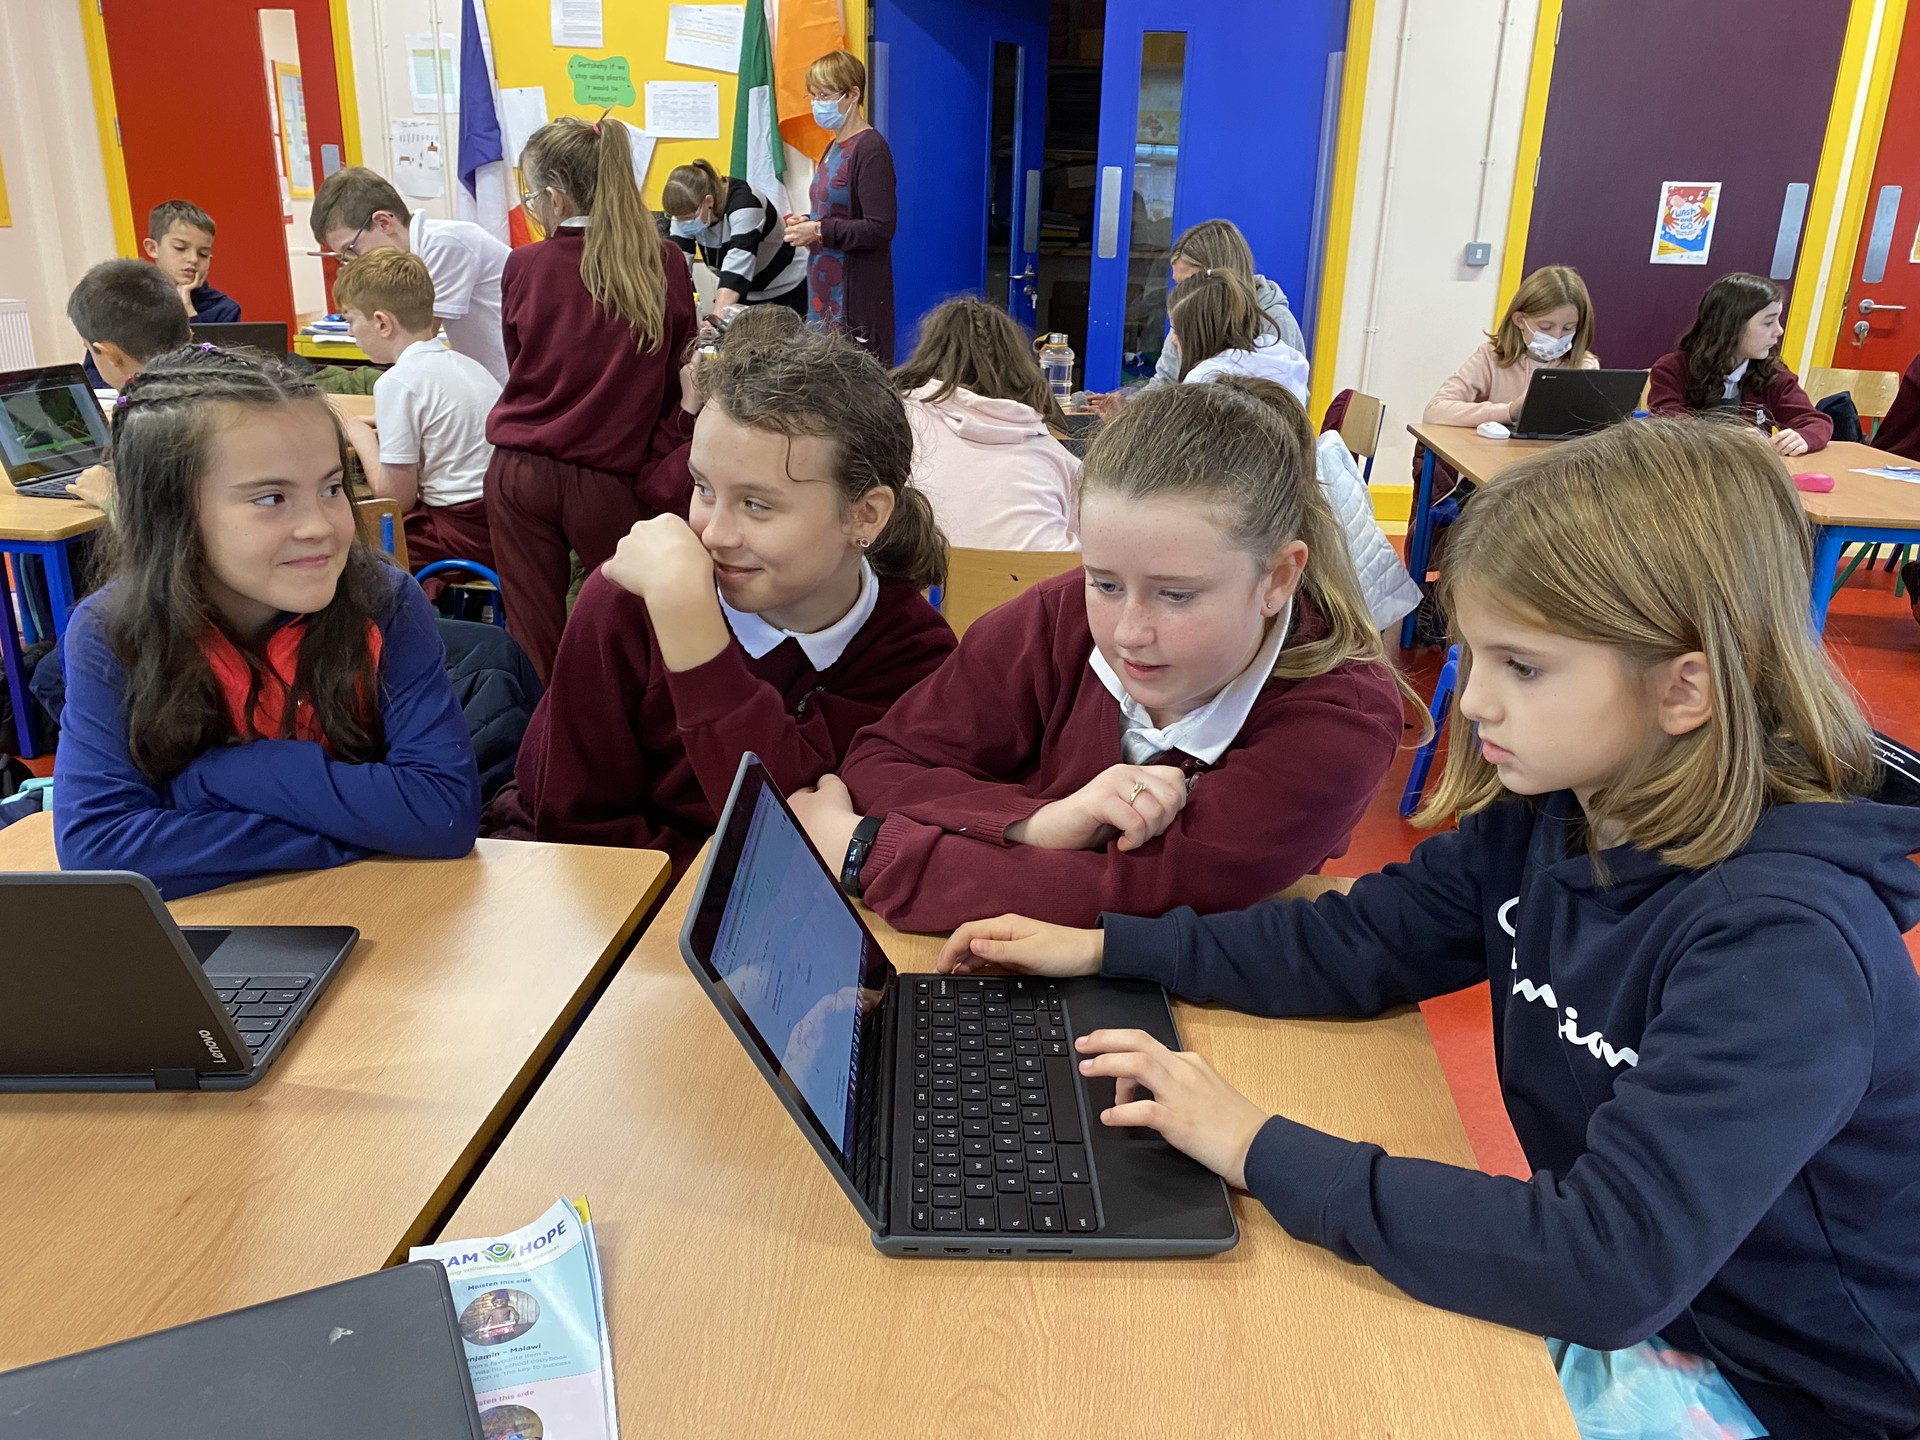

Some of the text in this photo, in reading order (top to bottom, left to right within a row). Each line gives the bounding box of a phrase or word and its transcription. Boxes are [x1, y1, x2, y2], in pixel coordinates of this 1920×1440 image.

[1680, 222, 1694, 230] GO
[198, 1029, 227, 1063] Lenovo
[444, 1220, 567, 1268] AM HOPE
[467, 1281, 498, 1291] Moisten
[467, 1351, 500, 1363] njamin
[510, 1343, 542, 1354] Malawi
[473, 1374, 492, 1383] ation
[478, 1389, 535, 1407] sten this side
